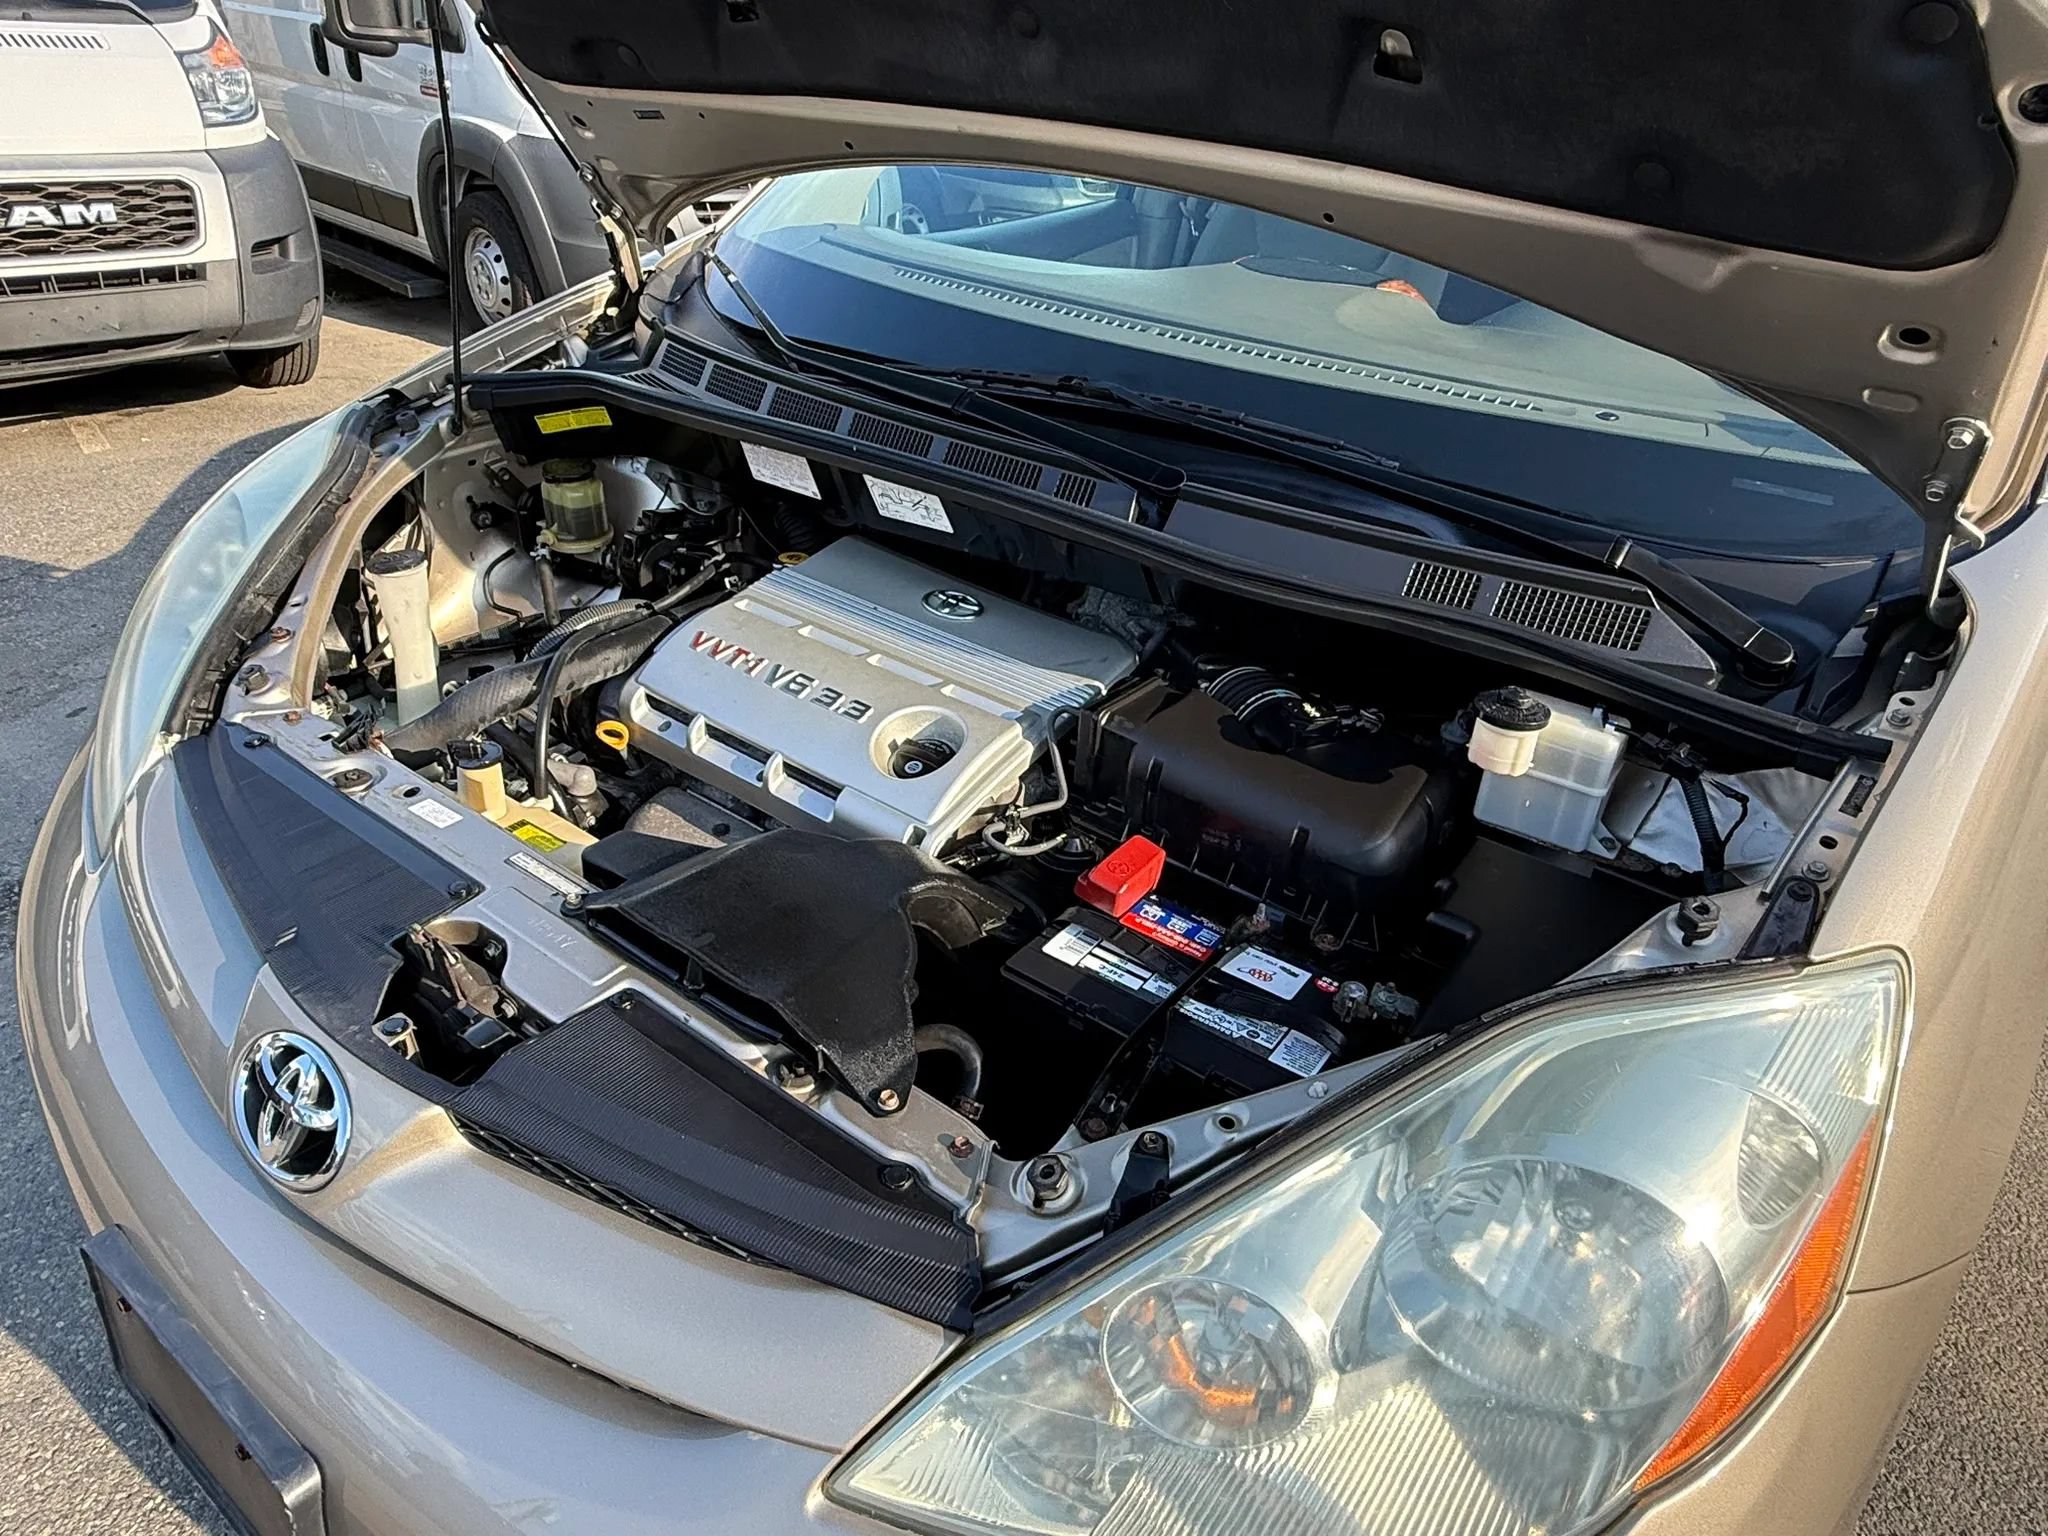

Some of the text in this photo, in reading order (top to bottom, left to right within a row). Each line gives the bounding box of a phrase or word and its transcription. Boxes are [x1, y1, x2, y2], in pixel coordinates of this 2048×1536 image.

[0, 202, 117, 228] AM
[764, 663, 819, 699] V6
[809, 686, 874, 724] 3.3
